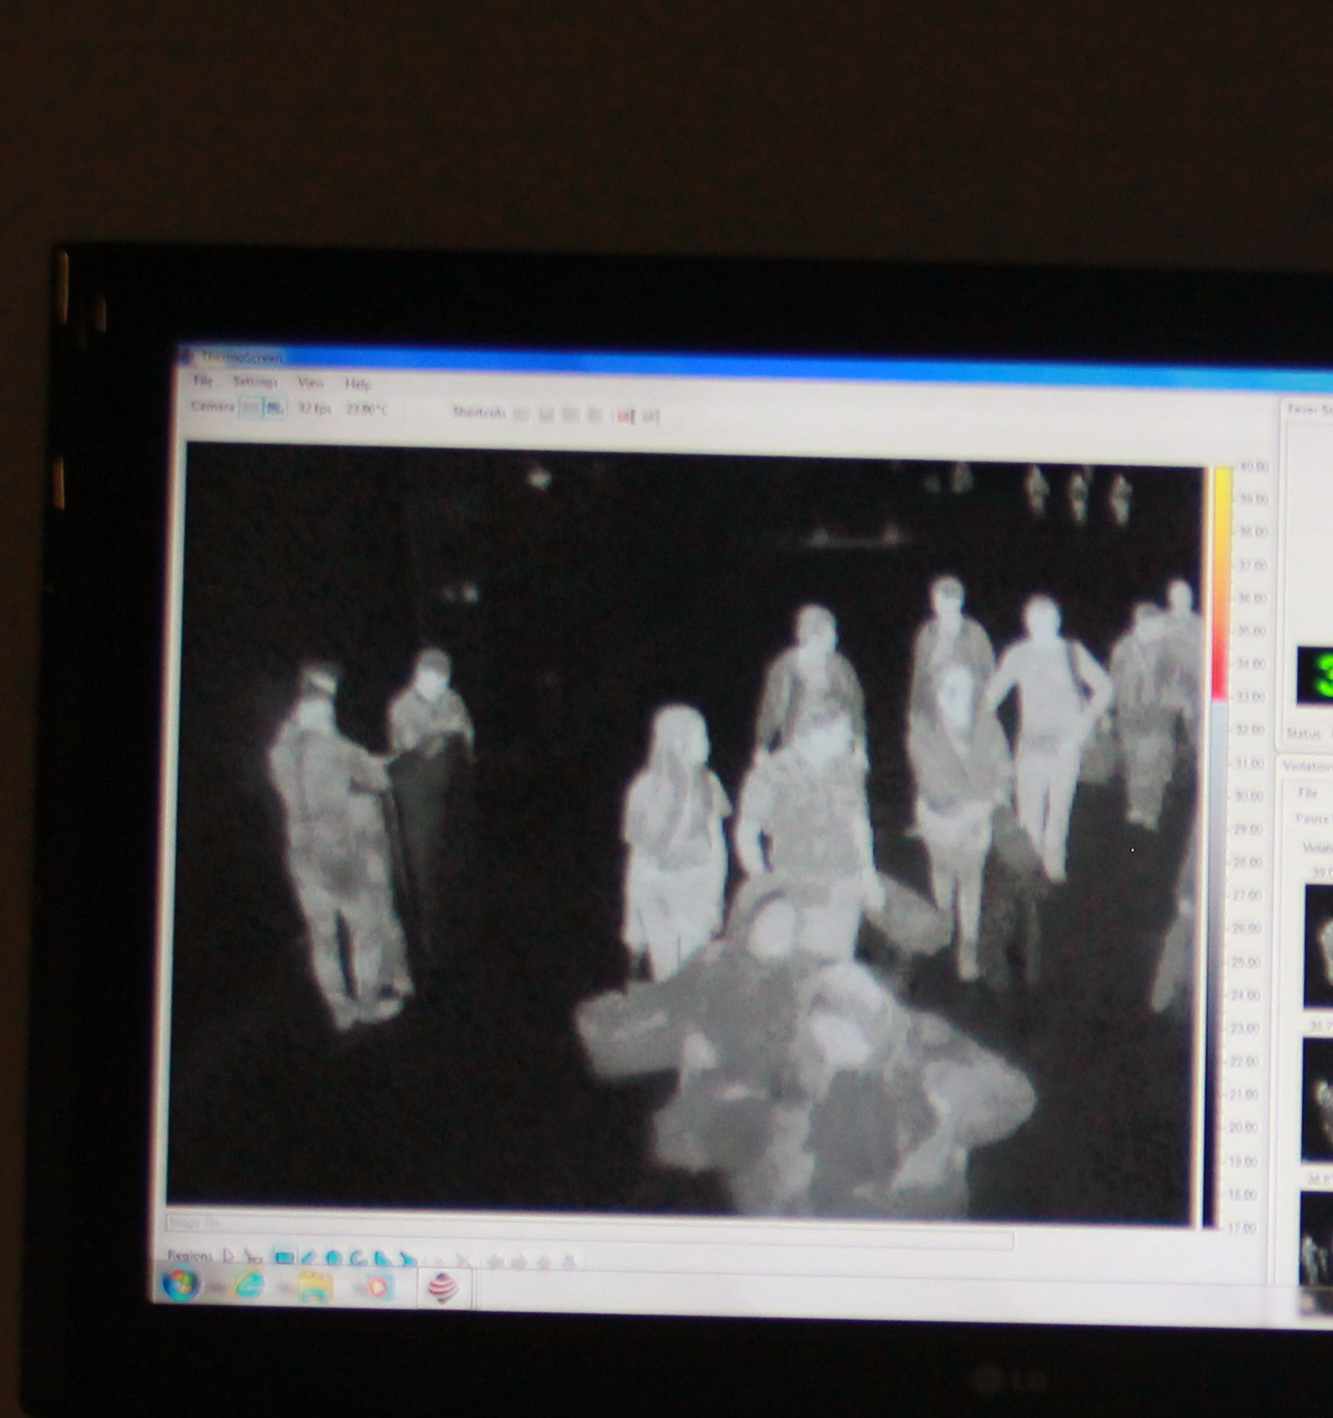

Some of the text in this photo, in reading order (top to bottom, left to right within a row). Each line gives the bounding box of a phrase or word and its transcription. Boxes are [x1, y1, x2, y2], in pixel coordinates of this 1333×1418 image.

[193, 373, 213, 388] File
[233, 374, 279, 390] Settings
[297, 375, 325, 389] View
[345, 375, 372, 392] Help
[190, 399, 236, 413] Camera
[452, 405, 507, 419] Shortcuts
[1298, 786, 1318, 799] File
[1295, 812, 1329, 826] Pause
[167, 1248, 213, 1262] Regions
